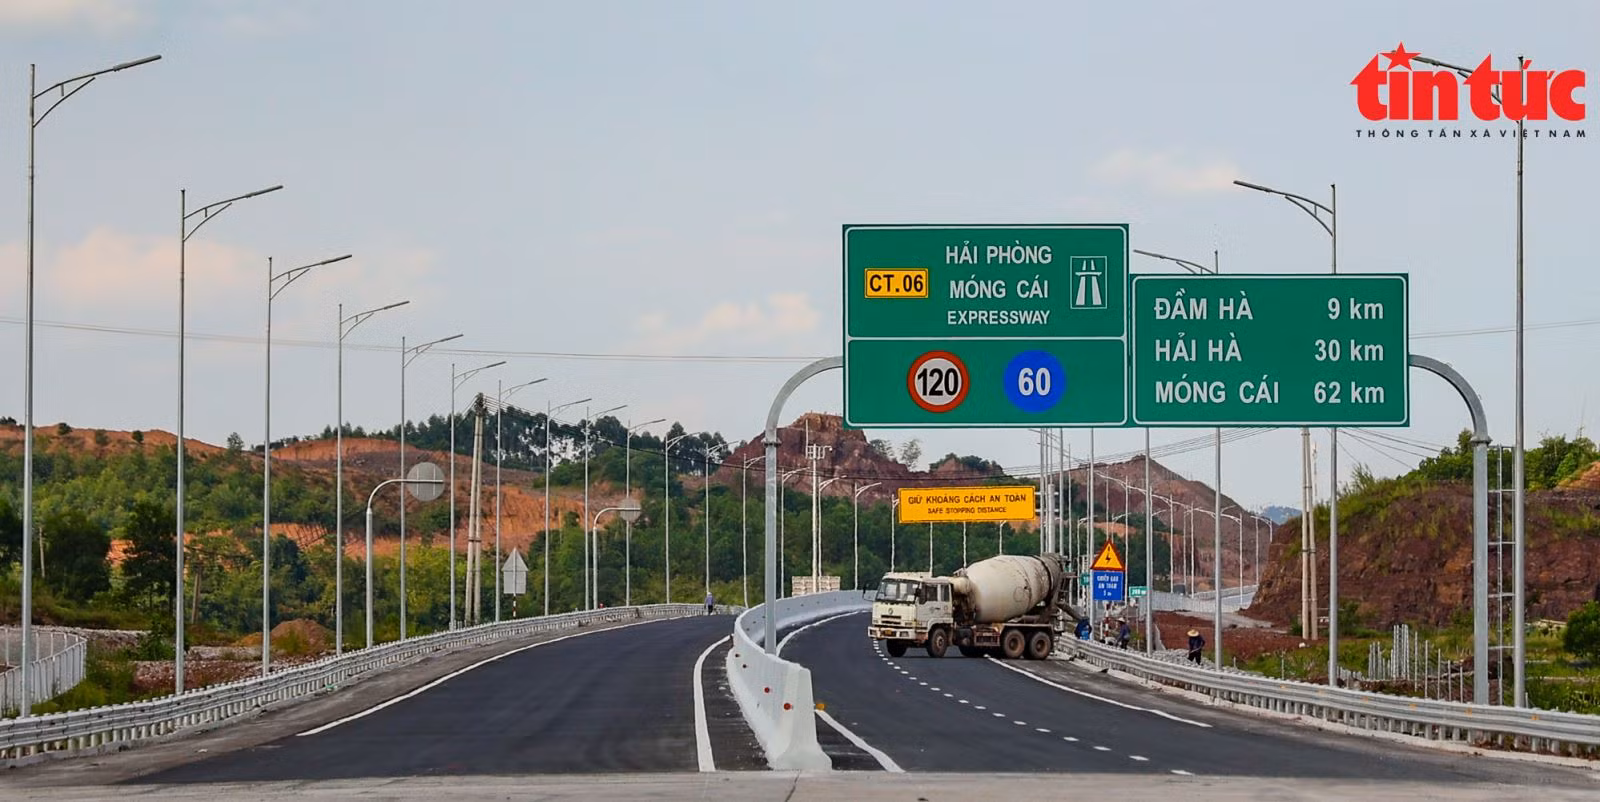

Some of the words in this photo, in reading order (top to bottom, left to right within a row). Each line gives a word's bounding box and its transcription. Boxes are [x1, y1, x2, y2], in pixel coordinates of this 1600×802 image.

[946, 240, 978, 264] HẢI
[986, 240, 1052, 264] PHÒNG
[869, 274, 924, 293] CT.06
[949, 274, 1006, 299] MÓNG
[1016, 274, 1049, 299] CÁI
[1153, 288, 1207, 320] ĐẦM
[1219, 290, 1254, 320] HÀ
[1327, 297, 1341, 320] 9
[1350, 297, 1384, 320] km
[947, 310, 1050, 325] EXPRESSWAY
[1155, 332, 1197, 362] HẢI
[1208, 332, 1242, 362] HÀ
[1314, 339, 1341, 362] 30
[1350, 339, 1384, 361] km
[917, 368, 959, 397] 120
[1018, 367, 1051, 396] 60
[1155, 373, 1226, 404] MÓNG
[1239, 374, 1279, 404] CÁI
[1314, 381, 1341, 404] 62
[1351, 381, 1385, 404] km
[989, 494, 1001, 503] AN
